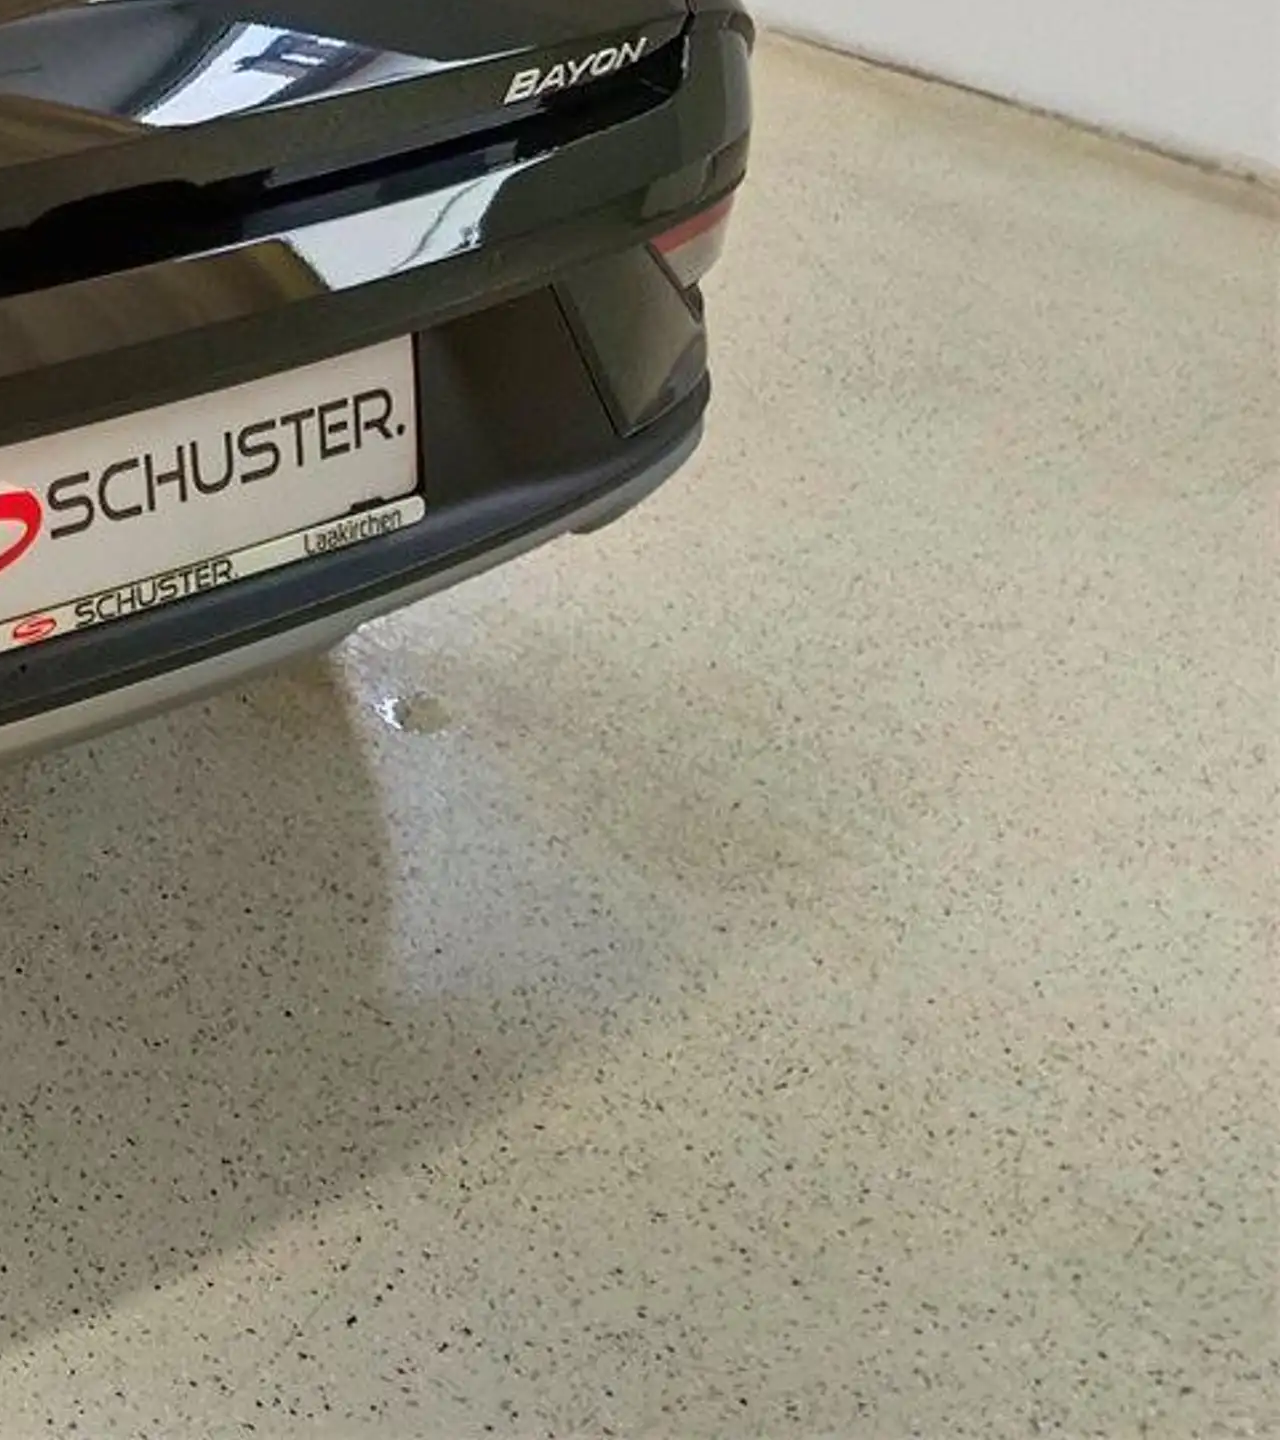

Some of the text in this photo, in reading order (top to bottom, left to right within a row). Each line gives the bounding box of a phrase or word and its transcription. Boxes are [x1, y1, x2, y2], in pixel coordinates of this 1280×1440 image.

[503, 37, 648, 106] BAYON
[47, 388, 407, 539] SCHUSTER.
[303, 507, 402, 555] Laakirchen
